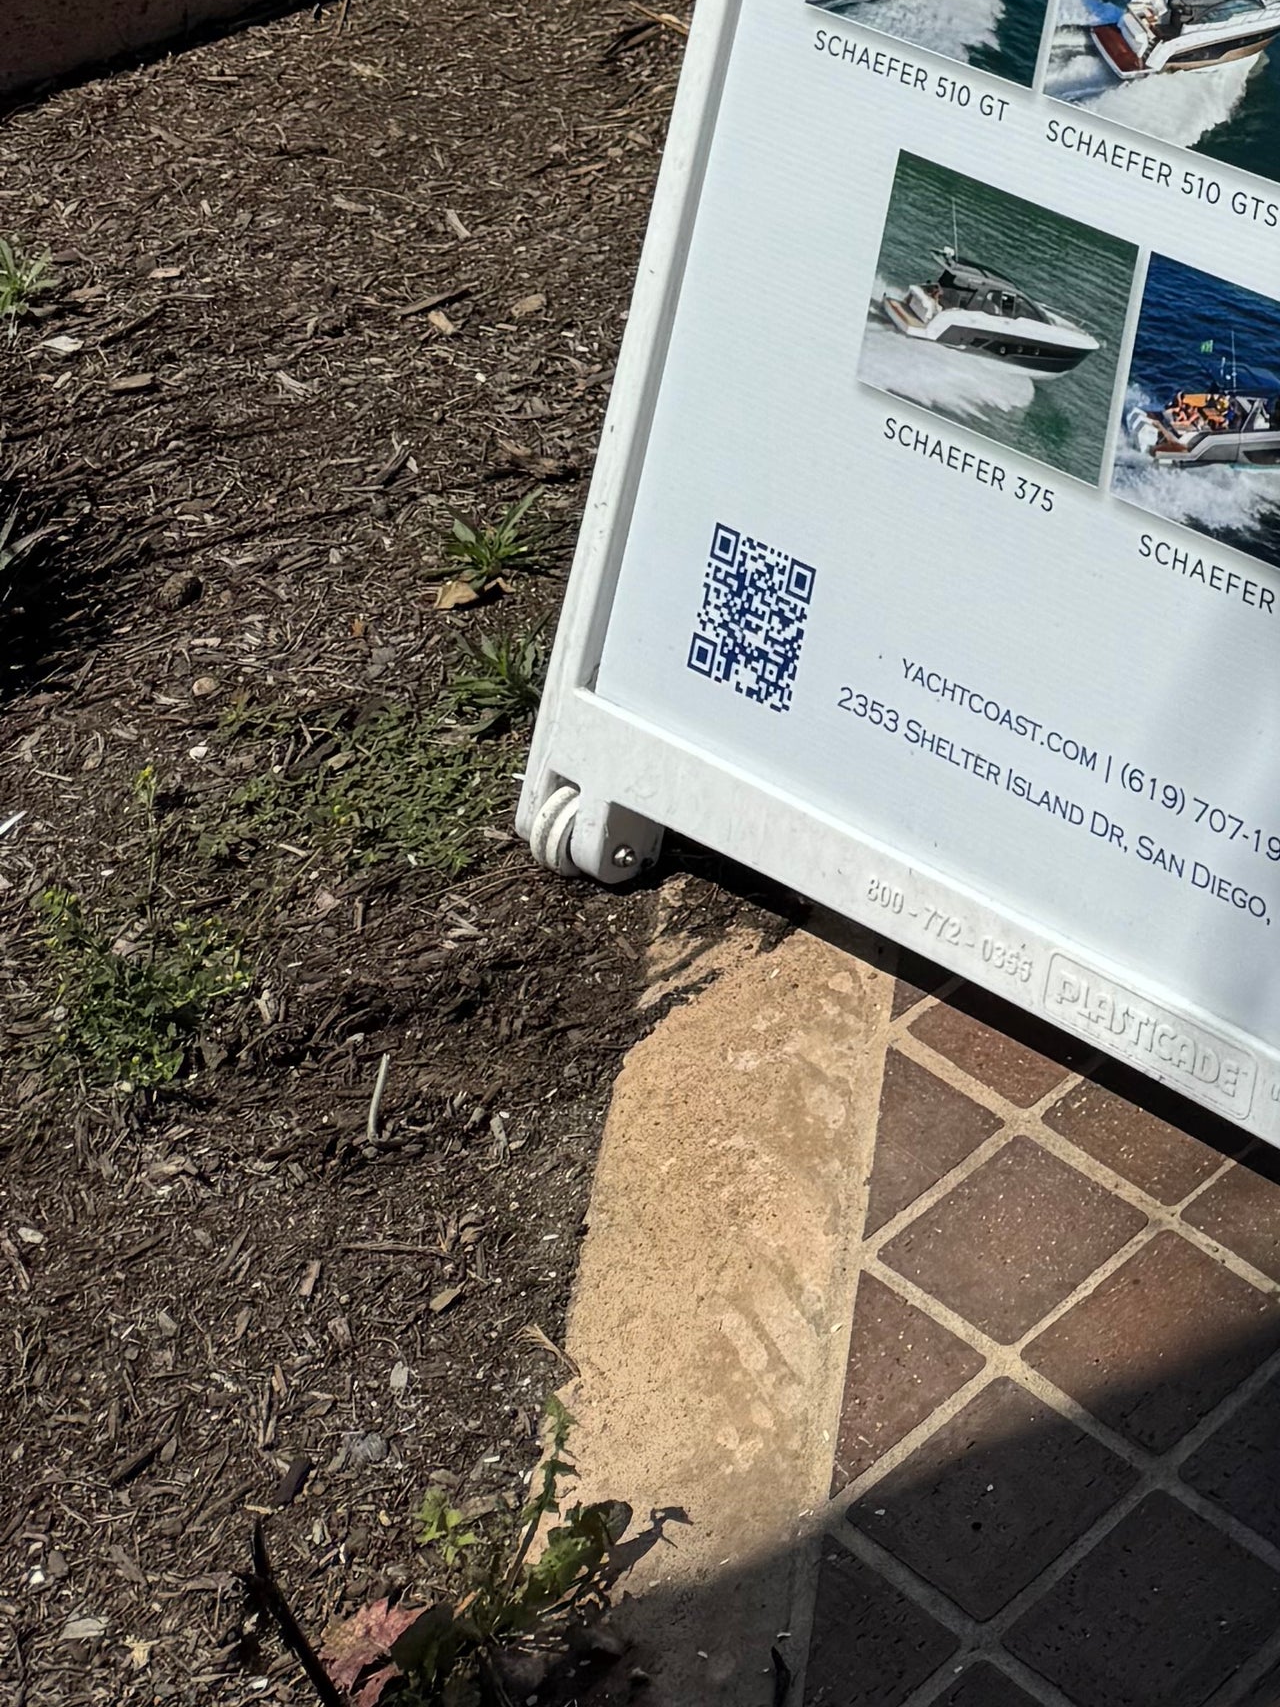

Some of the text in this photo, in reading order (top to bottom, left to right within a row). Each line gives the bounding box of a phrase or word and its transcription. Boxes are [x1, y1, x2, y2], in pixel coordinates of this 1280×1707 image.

[812, 28, 1010, 122] SCHAEFER 510 GT
[1044, 118, 1280, 228] SCHAEFER 510 GTS
[882, 416, 1055, 513] SCHAEFER 375
[1137, 533, 1276, 615] SCHAEFER
[836, 685, 900, 734] 2353
[1119, 760, 1187, 816] (619)
